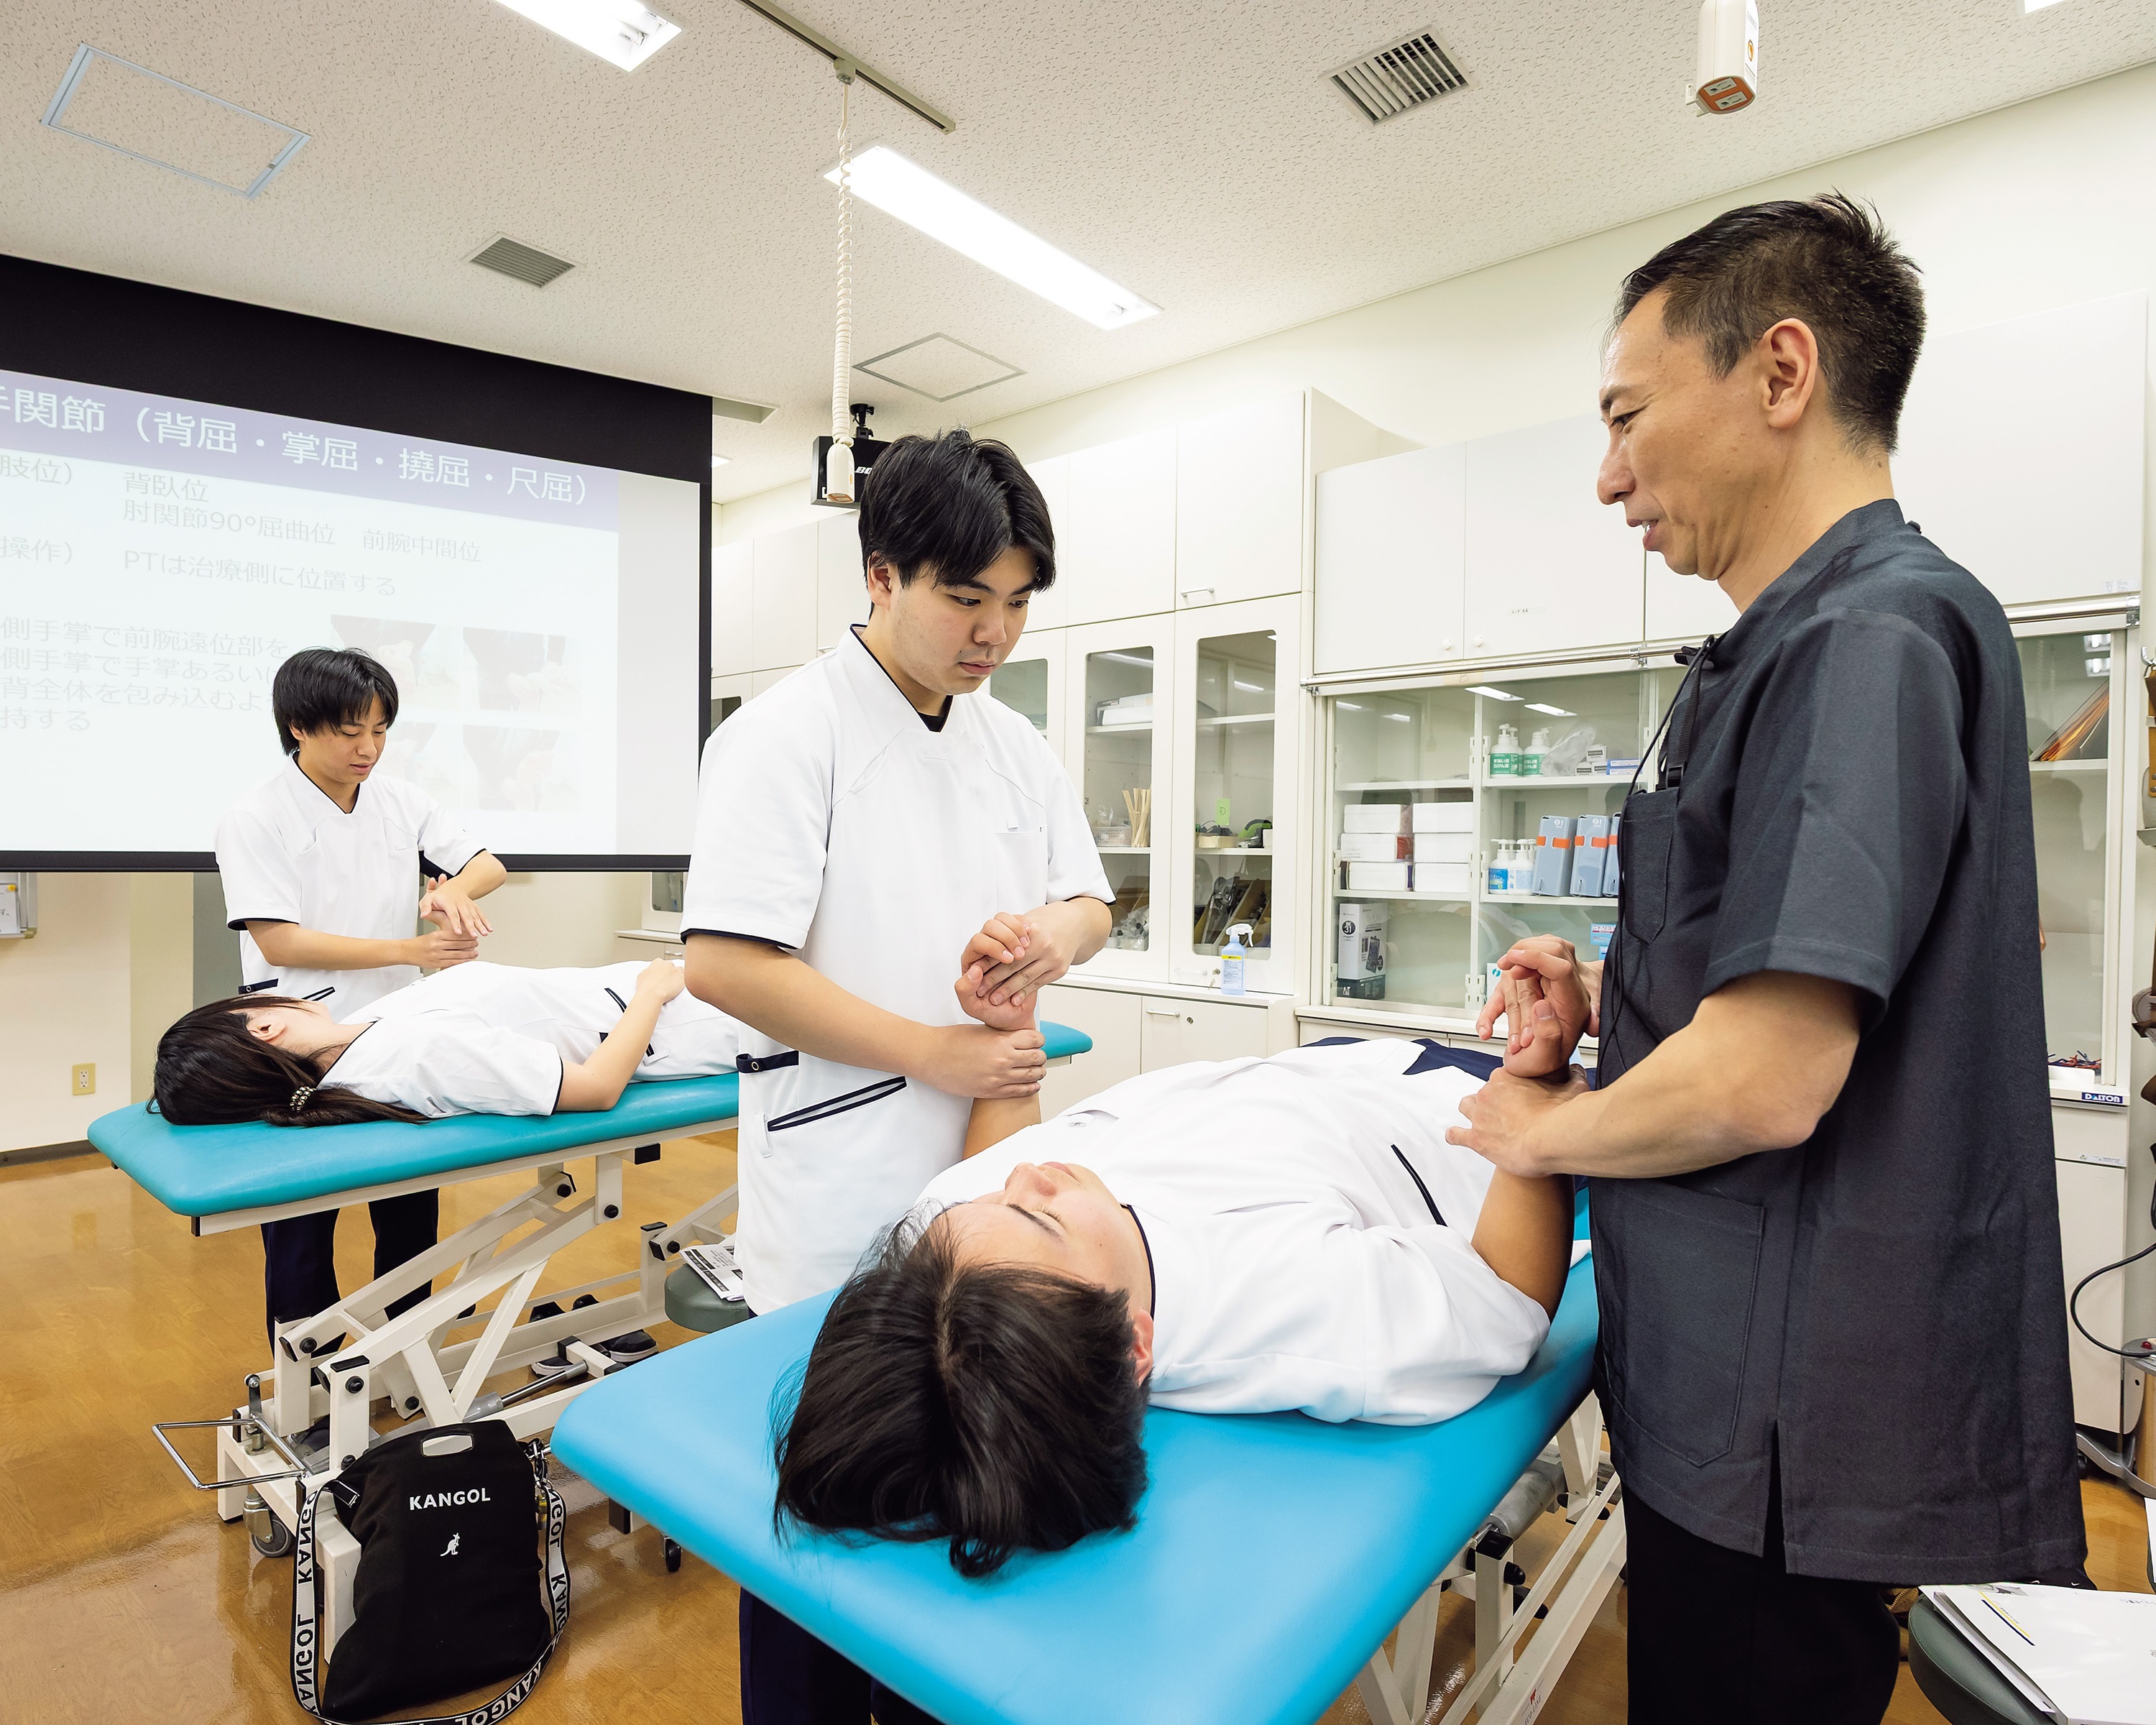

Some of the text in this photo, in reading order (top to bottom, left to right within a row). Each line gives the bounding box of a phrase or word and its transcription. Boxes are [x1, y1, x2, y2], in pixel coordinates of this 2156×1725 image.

[854, 466, 873, 474] BO
[123, 472, 210, 503] 背臥位
[362, 528, 482, 563] 前腕中間位
[124, 550, 395, 597] PTは治療側に位置する
[2084, 1093, 2121, 1103] DALTON
[409, 1487, 491, 1511] KANGOL
